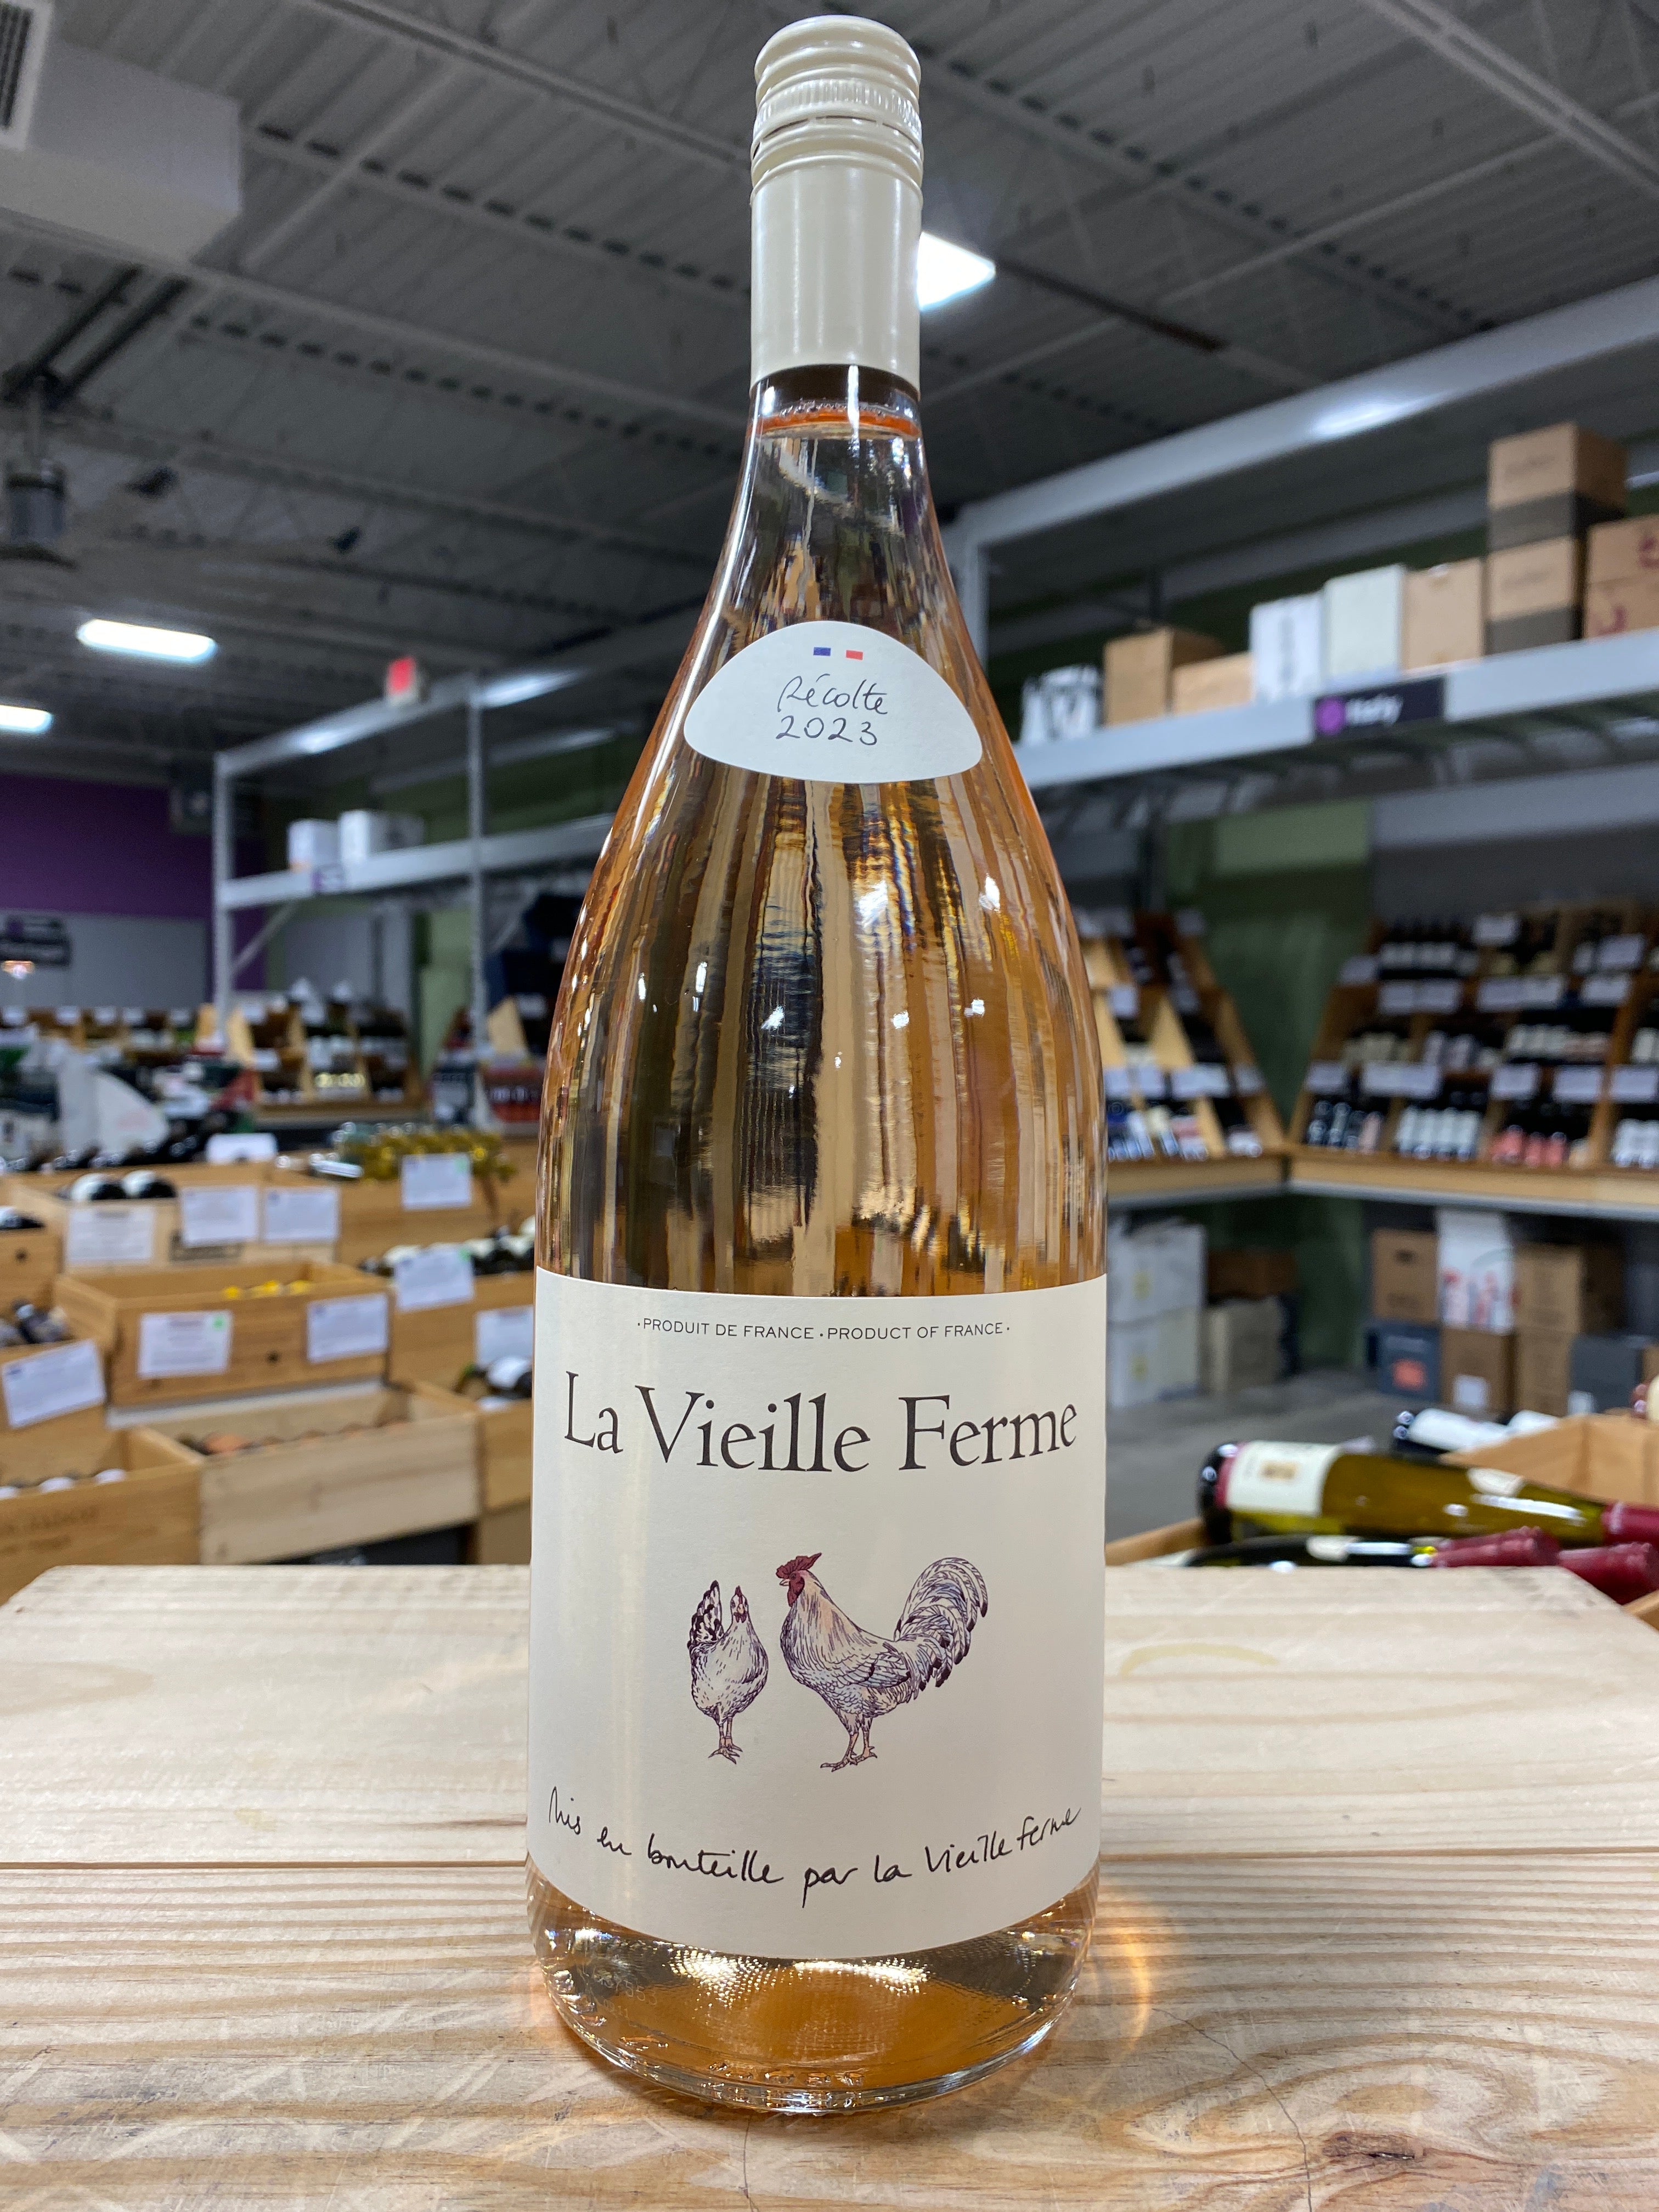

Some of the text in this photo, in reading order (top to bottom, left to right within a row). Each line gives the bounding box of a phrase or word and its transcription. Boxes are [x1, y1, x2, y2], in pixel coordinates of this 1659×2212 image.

[776, 673, 888, 715] Récolte
[775, 715, 878, 746] 2023
[643, 1318, 1003, 1340] PRODUIT DE FRANCE PRODUCT OF FRANCE
[564, 1370, 1077, 1472] La Vieille Ferme
[596, 1826, 632, 1856] en
[647, 1832, 785, 1884] bouteille
[802, 1867, 859, 1908] par
[873, 1854, 913, 1883] la
